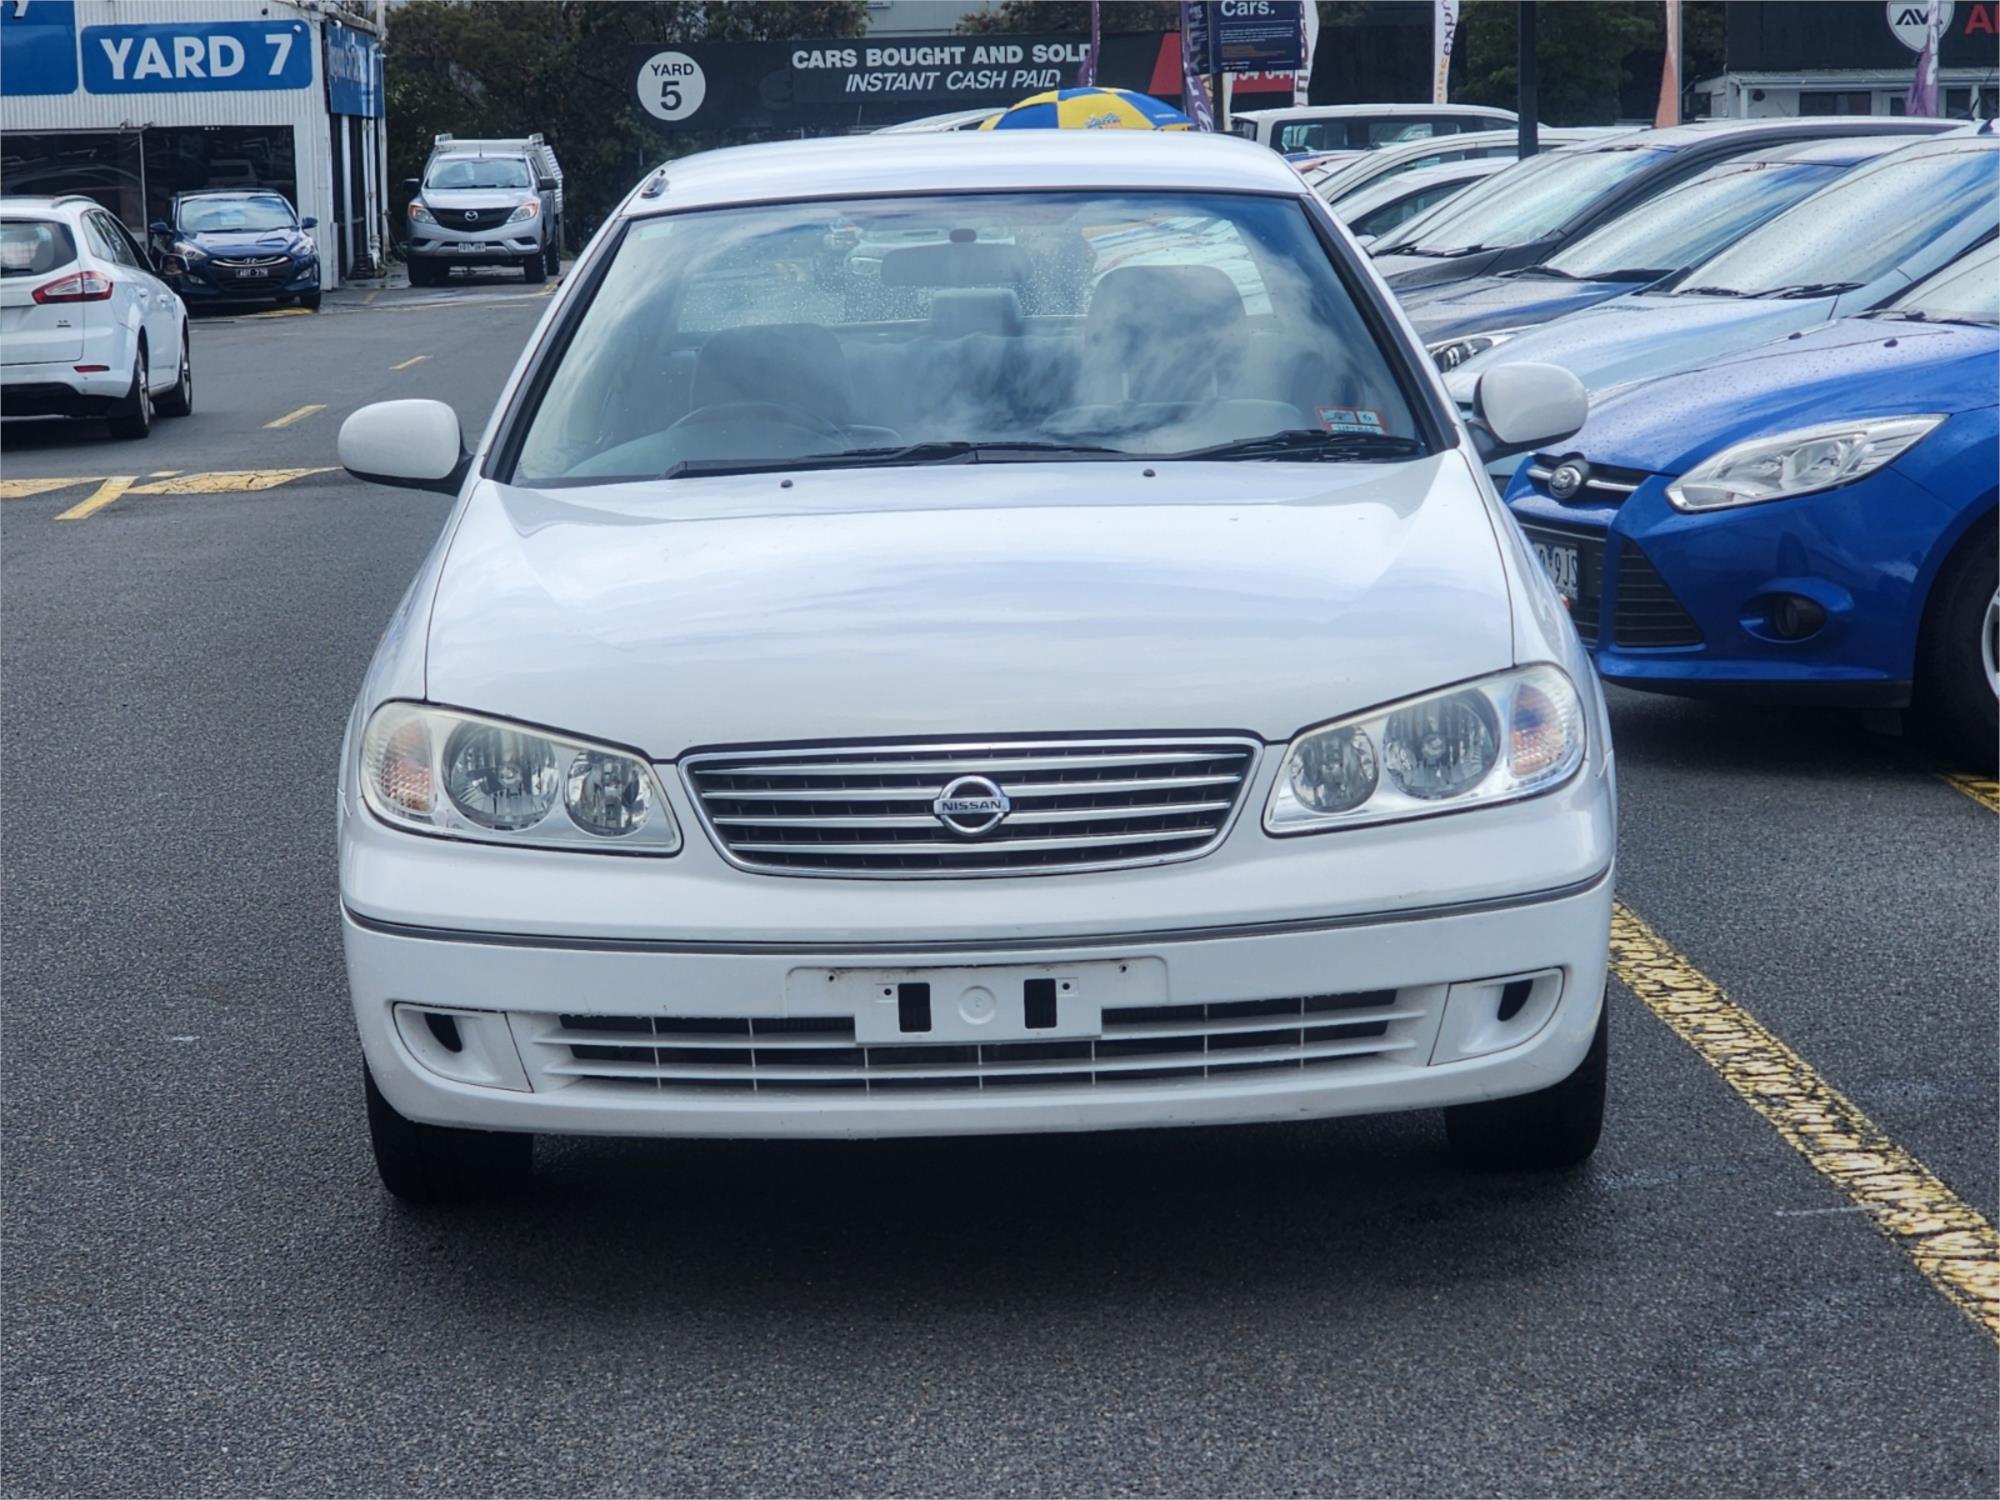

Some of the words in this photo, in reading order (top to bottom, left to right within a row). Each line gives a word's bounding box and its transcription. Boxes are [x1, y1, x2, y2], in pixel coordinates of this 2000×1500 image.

[1220, 0, 1276, 16] Cars.
[1441, 0, 1455, 56] expr
[100, 35, 245, 80] YARD
[264, 33, 293, 76] 7
[792, 49, 857, 69] CARS
[866, 46, 964, 67] BOUGHT
[972, 45, 1023, 65] AND
[651, 63, 694, 76] YARD
[845, 72, 940, 92] INSTANT
[946, 70, 1007, 89] CASH
[1011, 69, 1061, 88] PAID
[660, 81, 682, 111] 5
[942, 801, 1000, 811] NISSAN
